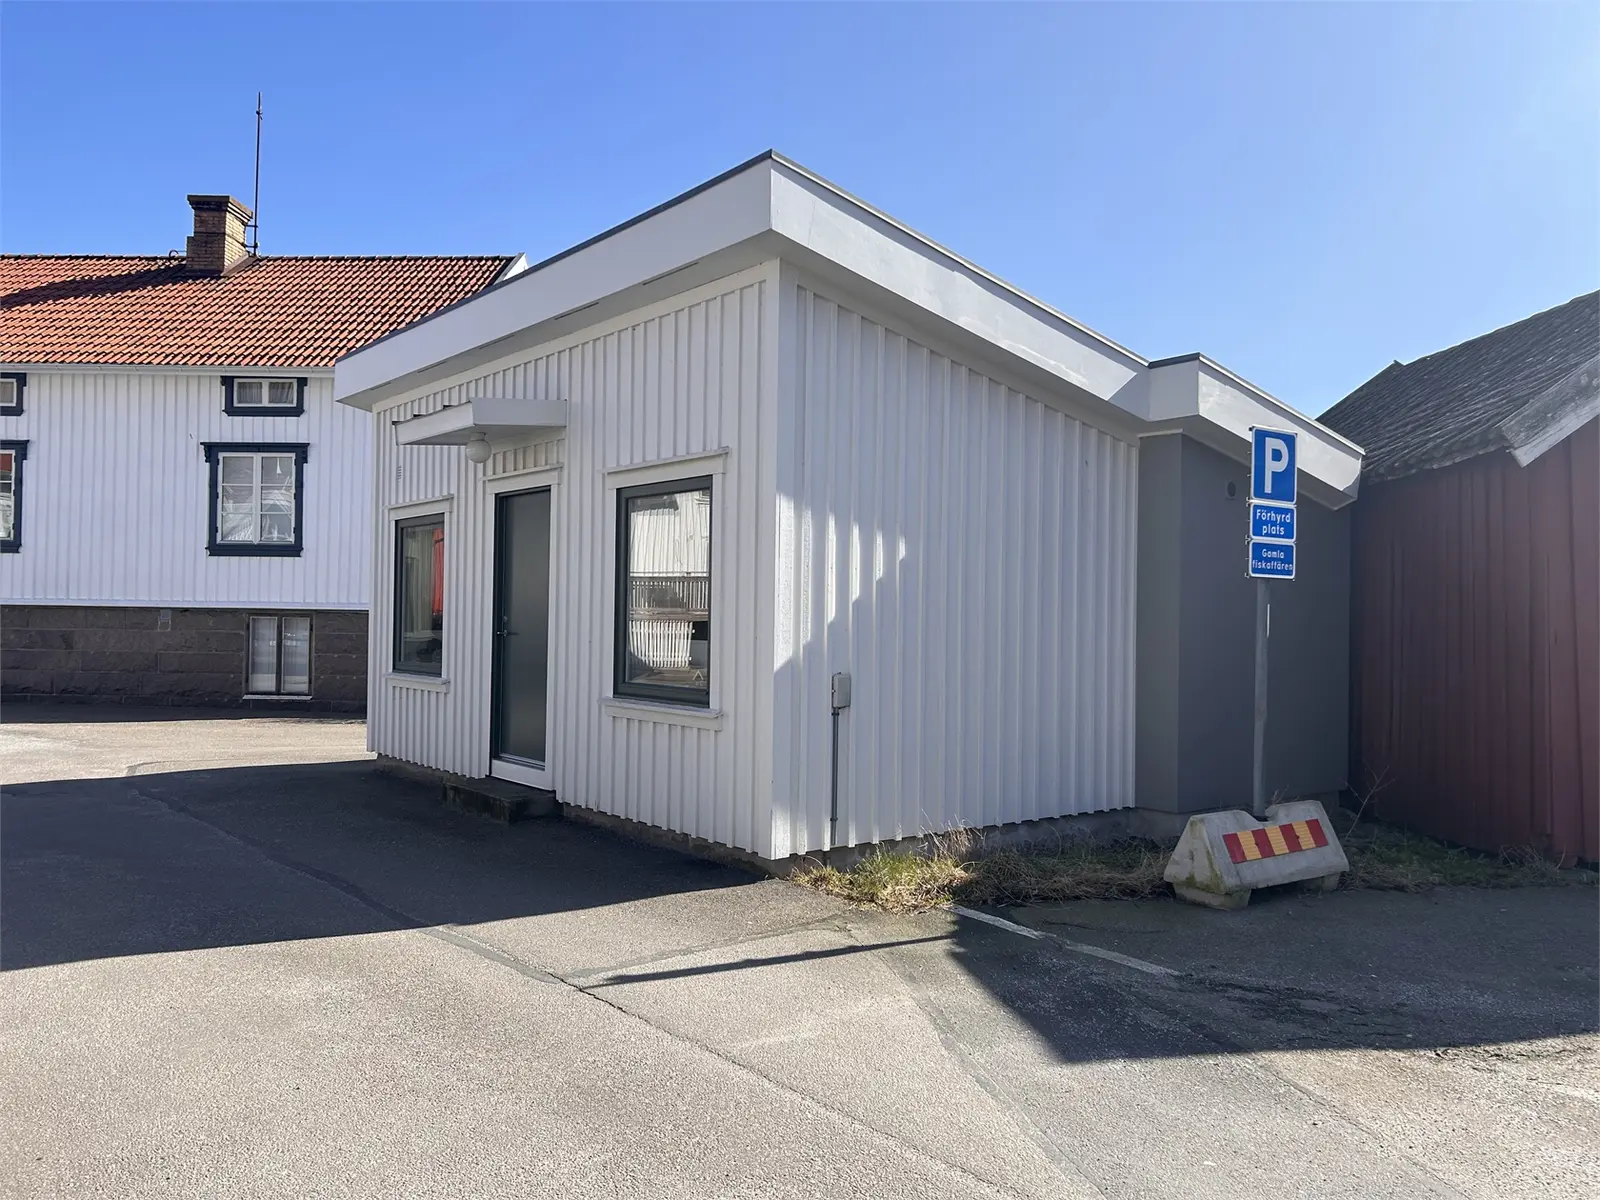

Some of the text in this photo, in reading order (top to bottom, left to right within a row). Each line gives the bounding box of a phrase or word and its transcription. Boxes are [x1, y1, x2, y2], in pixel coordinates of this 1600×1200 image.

[1264, 437, 1289, 494] P
[1256, 509, 1291, 524] Förhyrd
[1262, 524, 1285, 535] plats
[1261, 548, 1285, 559] Gamla
